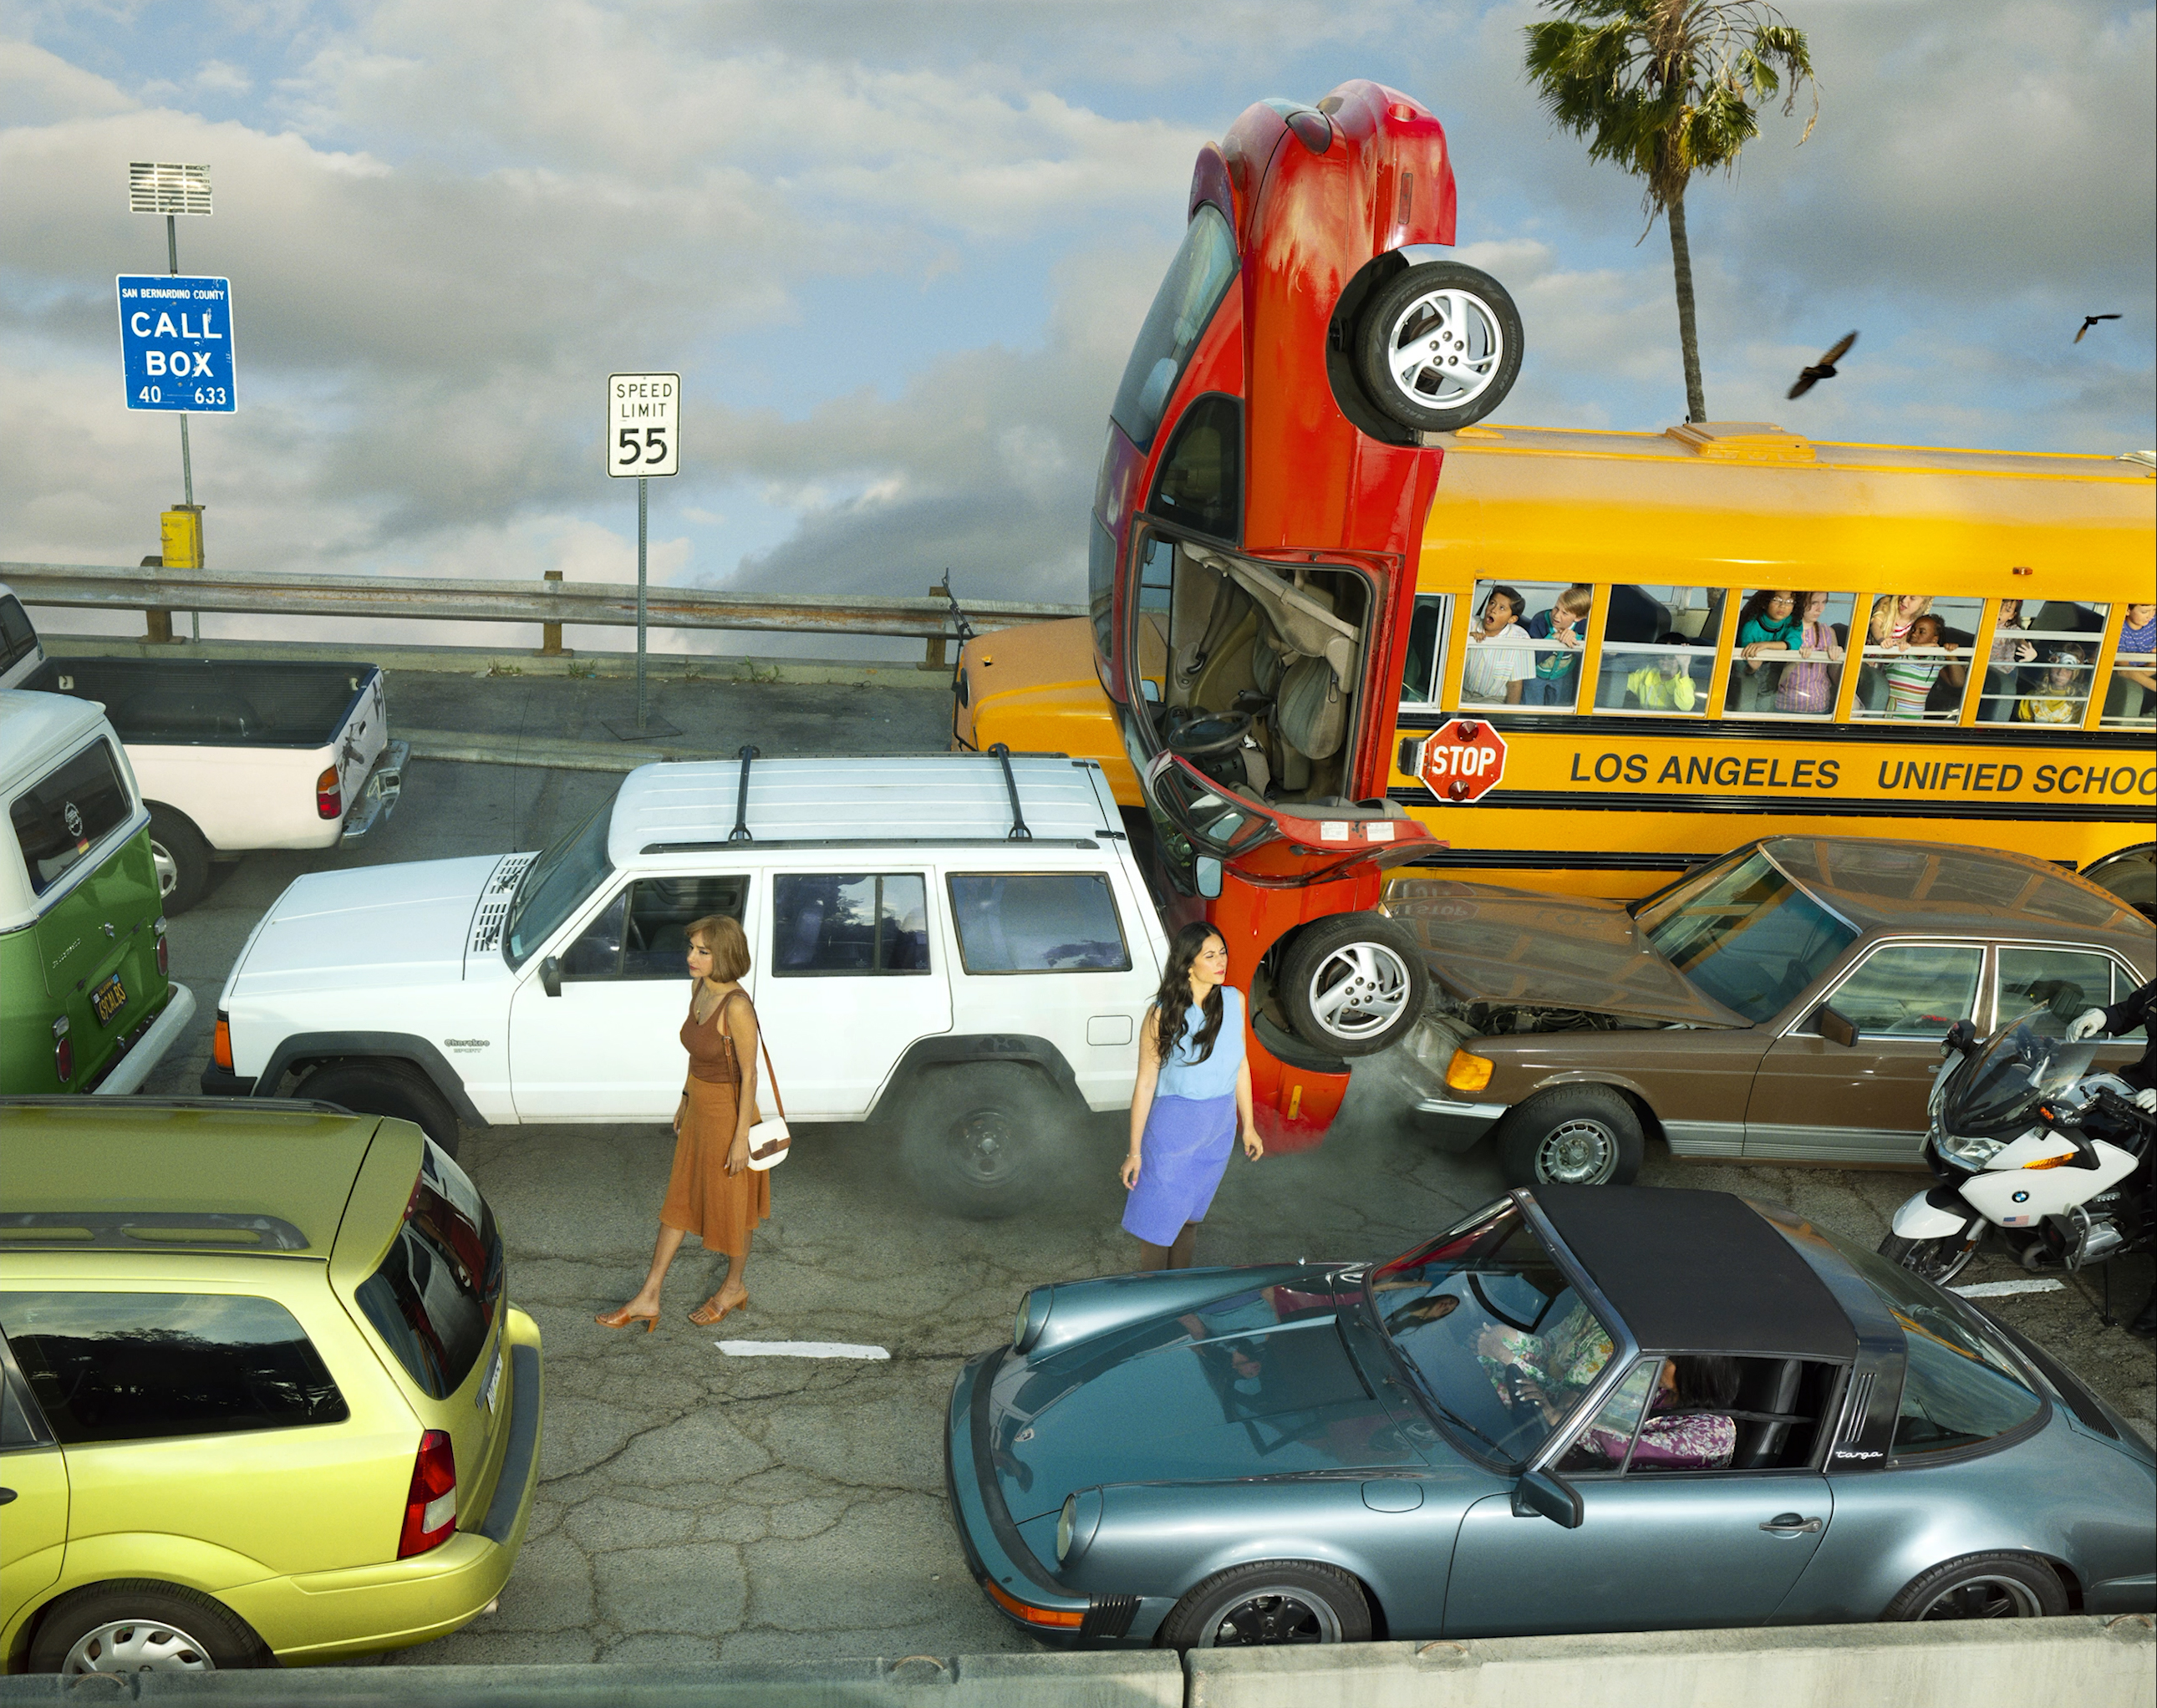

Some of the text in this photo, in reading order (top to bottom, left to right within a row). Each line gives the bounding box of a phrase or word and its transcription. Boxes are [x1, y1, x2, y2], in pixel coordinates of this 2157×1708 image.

[122, 288, 224, 300] SAN BERNARDINO COUNTY
[131, 312, 222, 338] CALL
[145, 350, 214, 378] BOX
[139, 385, 226, 404] 40 633
[617, 384, 672, 398] SPEED
[622, 403, 666, 418] LIMIT
[618, 427, 668, 465] 55
[1432, 745, 1496, 776] STOP
[1570, 753, 2156, 795] LOS ANGELES UNIFIED SCHOO
[444, 1039, 491, 1047] Cherokee
[1835, 1450, 1884, 1460] targa
